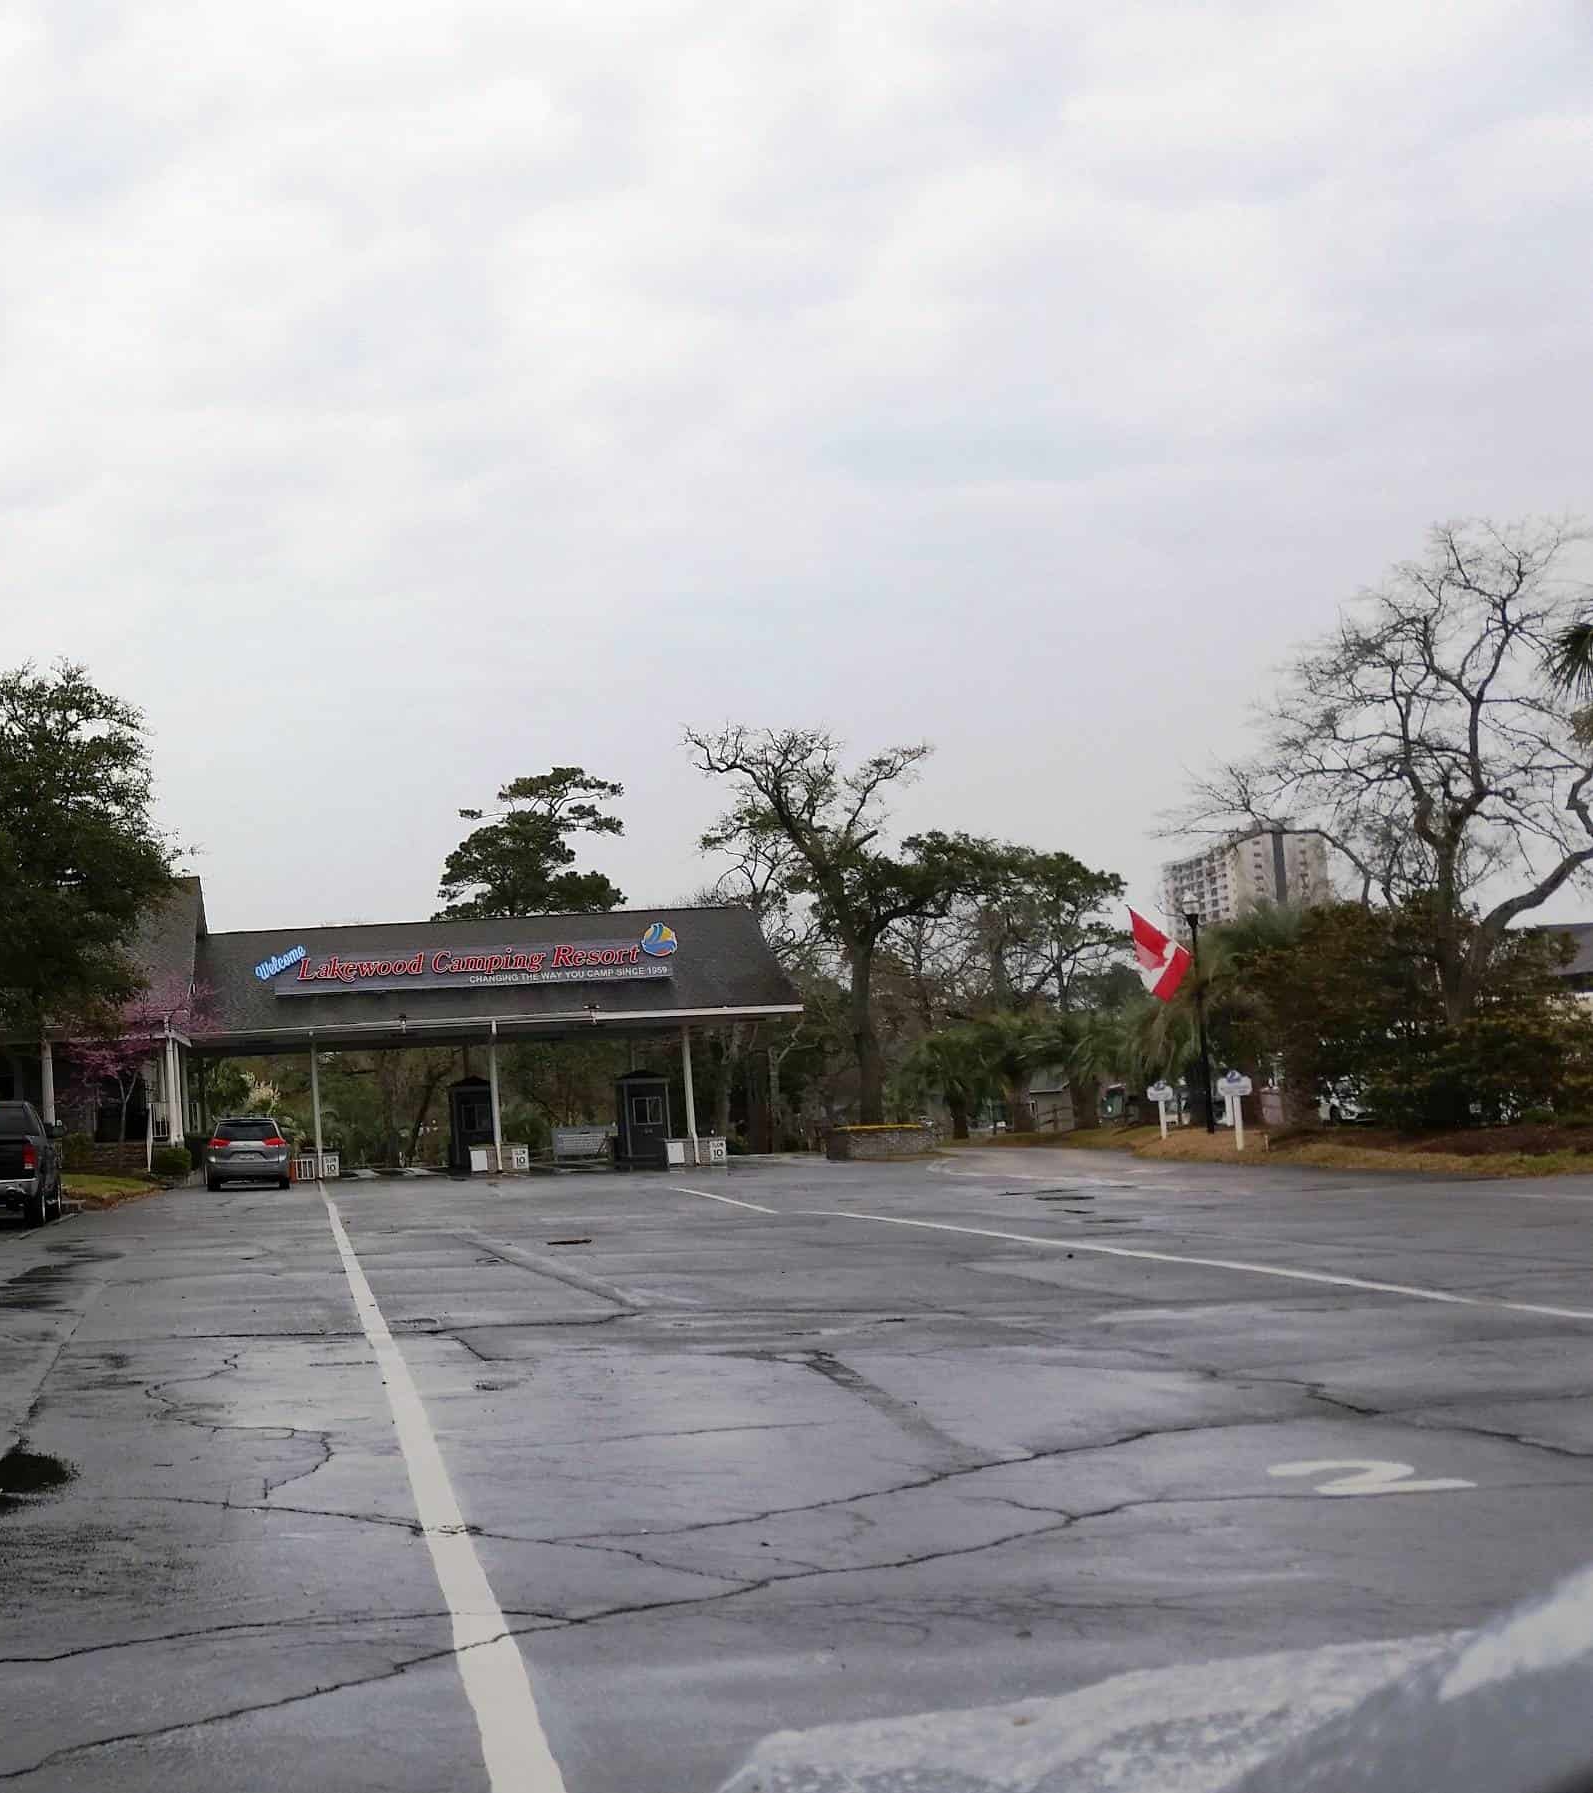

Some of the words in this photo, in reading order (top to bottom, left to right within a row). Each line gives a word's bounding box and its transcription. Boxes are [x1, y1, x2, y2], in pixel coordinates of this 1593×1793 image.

[255, 944, 306, 980] Welcome
[297, 952, 424, 983] Lakewood
[432, 947, 546, 975] Camping
[551, 944, 640, 968] Resort
[469, 974, 519, 984] CHANGING
[521, 973, 540, 982] THE
[541, 971, 561, 980] WAY
[566, 970, 585, 979] YOU
[587, 968, 614, 978] CAMP
[617, 966, 645, 977] SINCE
[647, 965, 667, 975] 1959
[713, 1149, 723, 1157] 10
[1266, 1459, 1478, 1496] 2
